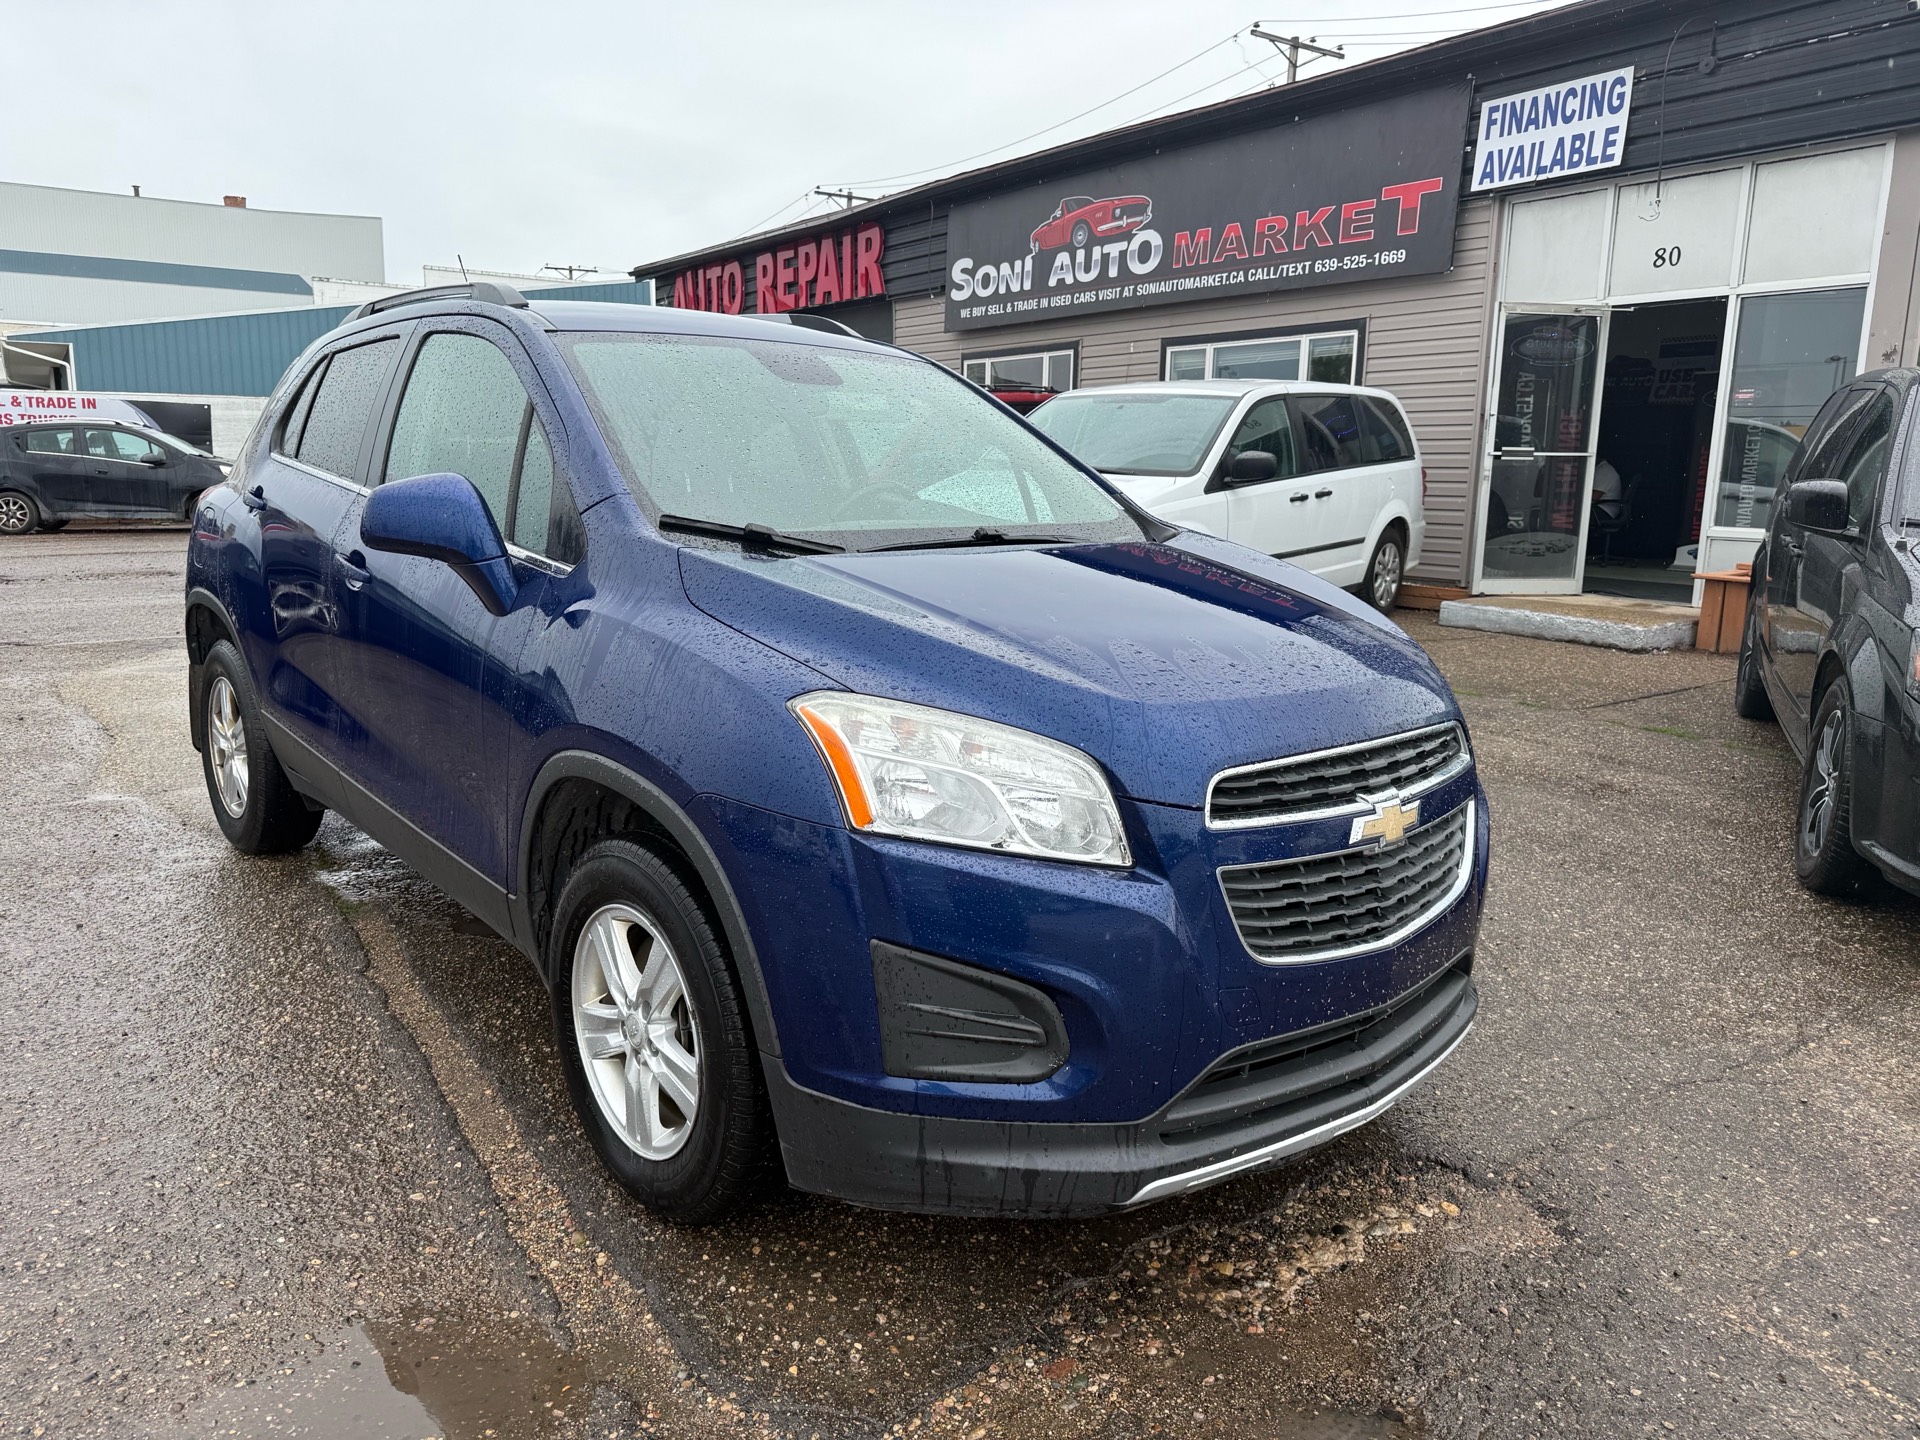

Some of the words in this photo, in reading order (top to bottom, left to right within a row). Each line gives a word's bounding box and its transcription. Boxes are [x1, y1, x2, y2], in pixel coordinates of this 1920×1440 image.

[1484, 76, 1627, 141] FINANCING
[1478, 125, 1620, 186] AVAILABLE
[673, 258, 744, 315] AUTO
[756, 221, 885, 314] REPAIR
[950, 254, 1033, 301] SONI
[1048, 229, 1163, 287] AUTO
[1172, 177, 1443, 269] MARKET
[1652, 245, 1681, 268] 80
[960, 308, 971, 319] WE
[972, 306, 986, 317] BUY
[987, 304, 1004, 315] SELL
[1006, 303, 1012, 313] &
[1013, 300, 1038, 312] TRADE
[1040, 298, 1049, 308] IN
[1050, 295, 1072, 307] USED
[1073, 292, 1096, 304] CARS
[1098, 288, 1121, 301] VISIT
[1123, 286, 1133, 298] AT
[1136, 272, 1245, 296] SONIAUTOMARKET.CA
[1248, 261, 1311, 282] CALL/TEXT
[1314, 249, 1406, 273] 639-525-1669
[11, 395, 22, 407] &
[25, 396, 77, 409] TRADE
[81, 397, 97, 410] IN
[1659, 368, 1697, 383] USE
